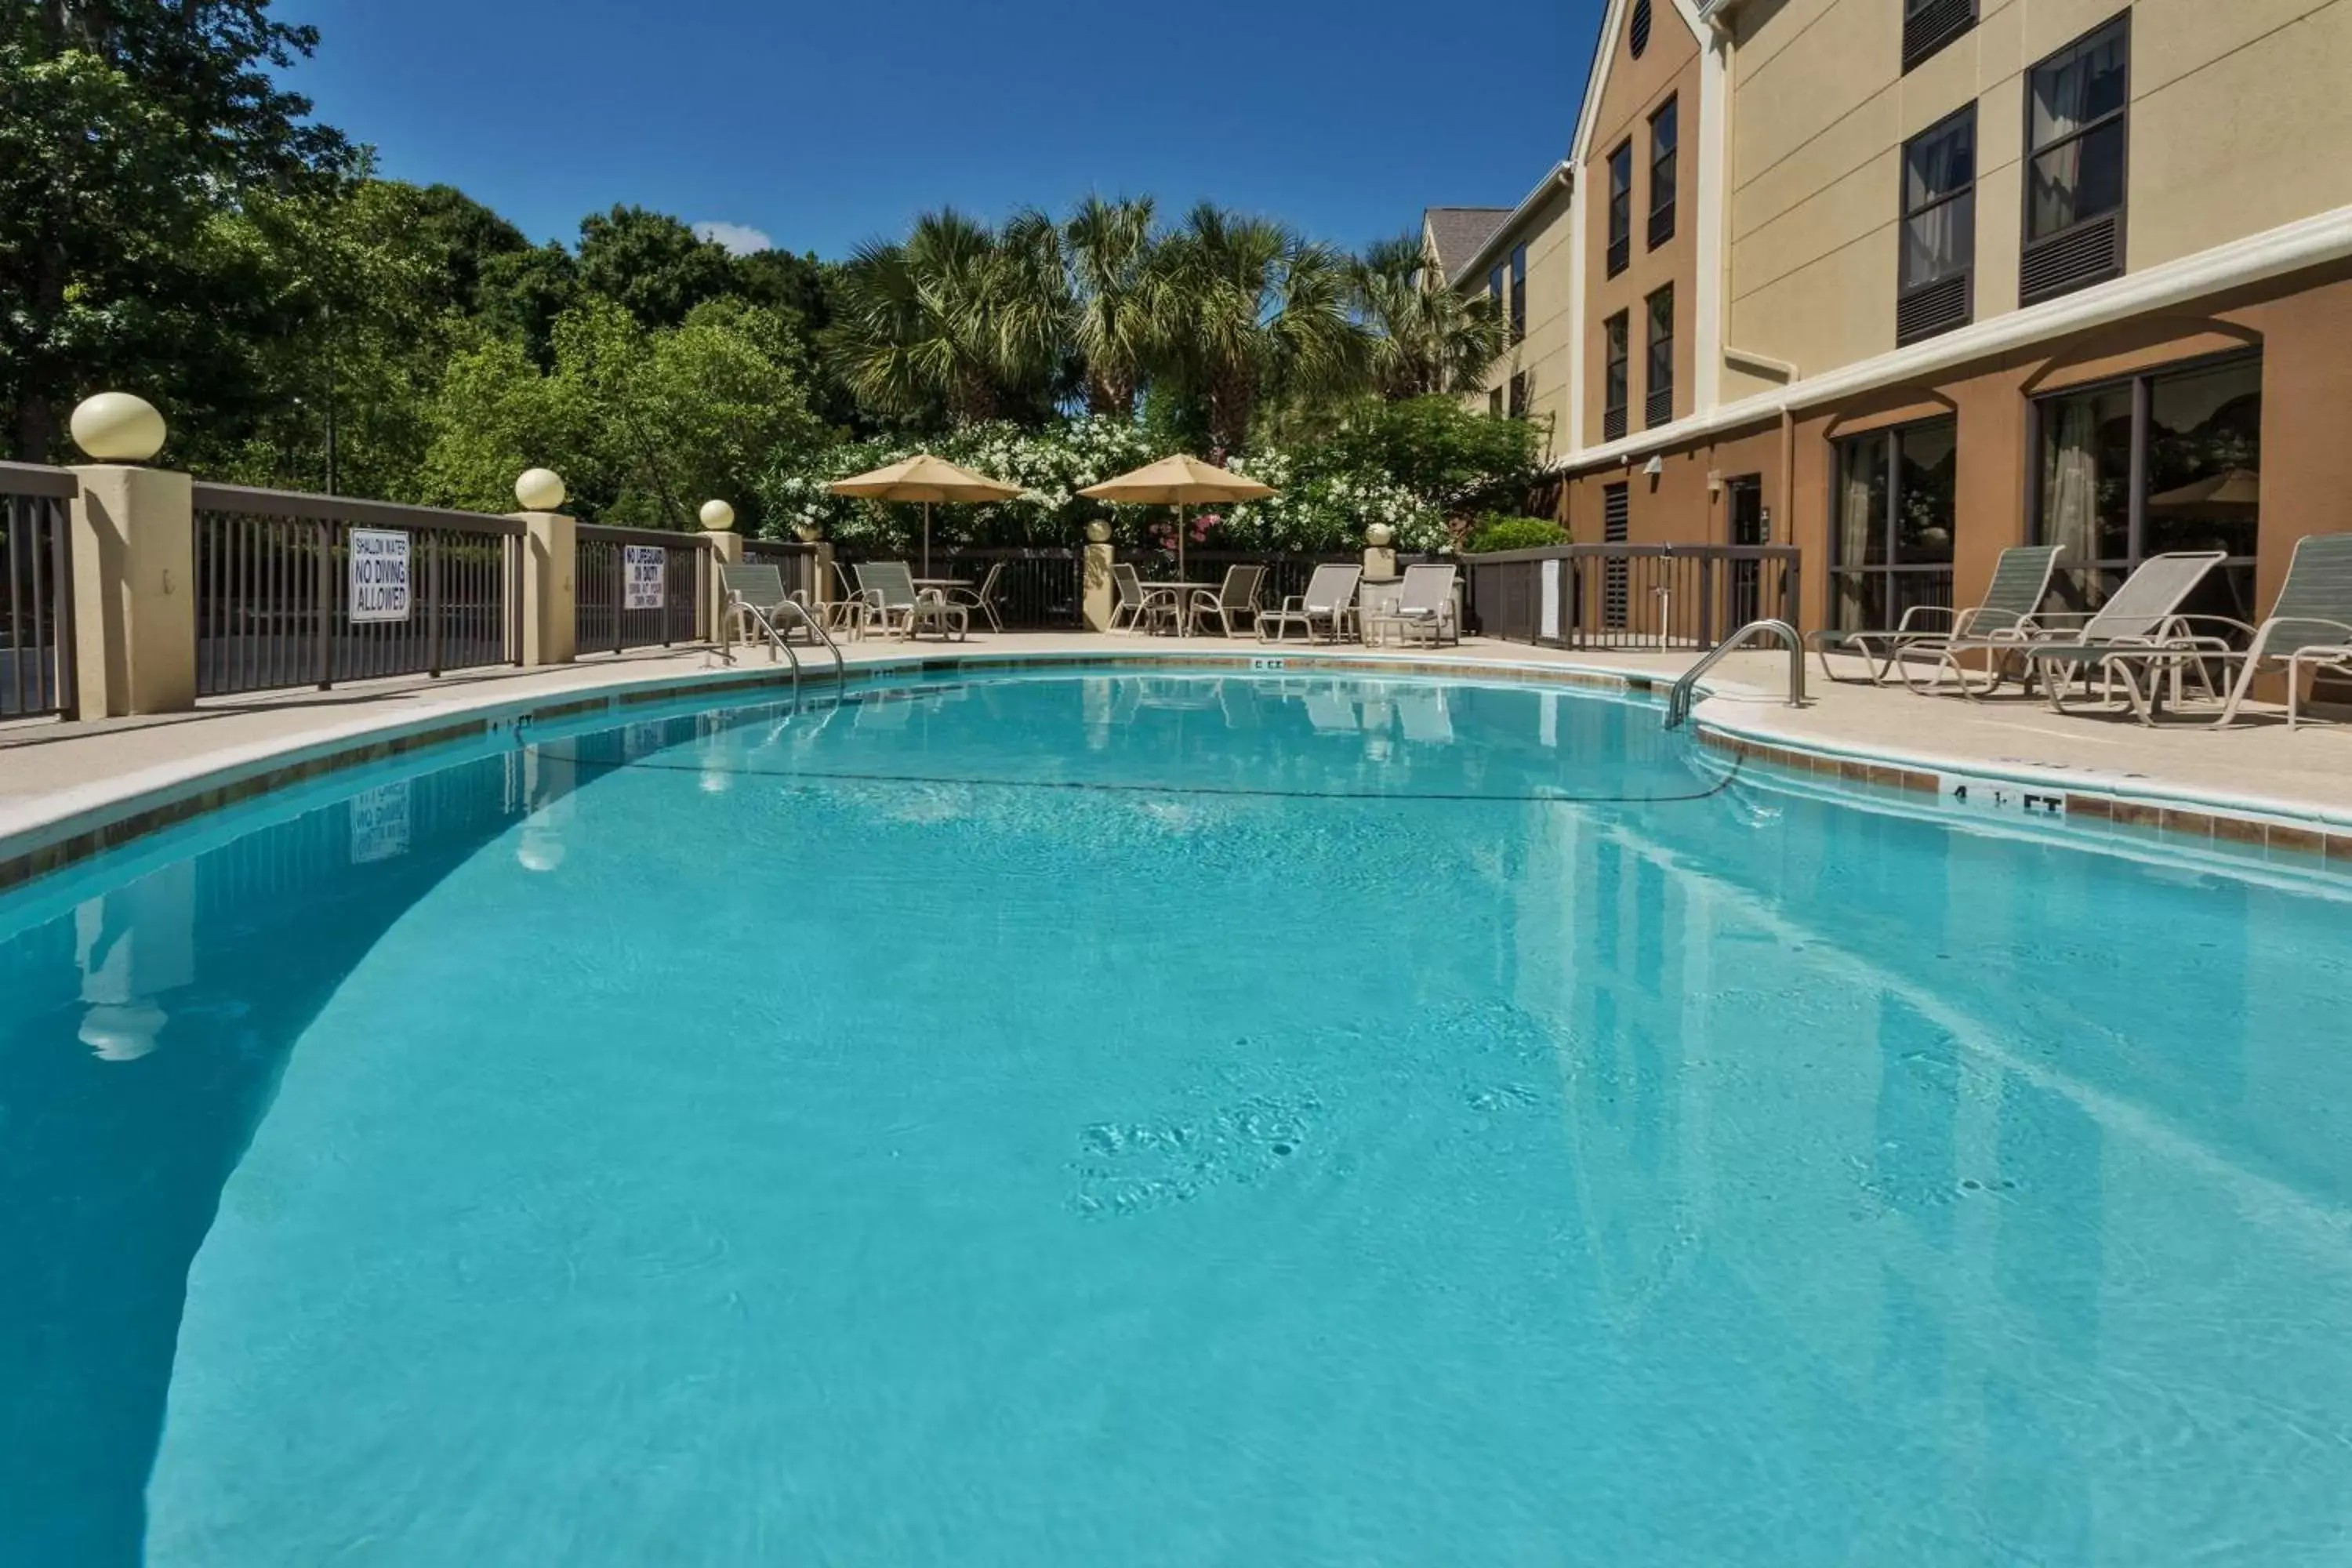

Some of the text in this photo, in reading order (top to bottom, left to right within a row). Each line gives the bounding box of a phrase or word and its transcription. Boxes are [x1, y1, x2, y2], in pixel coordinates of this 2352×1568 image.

[356, 560, 405, 584] NO DIVING
[358, 586, 405, 612] ALLOWED
